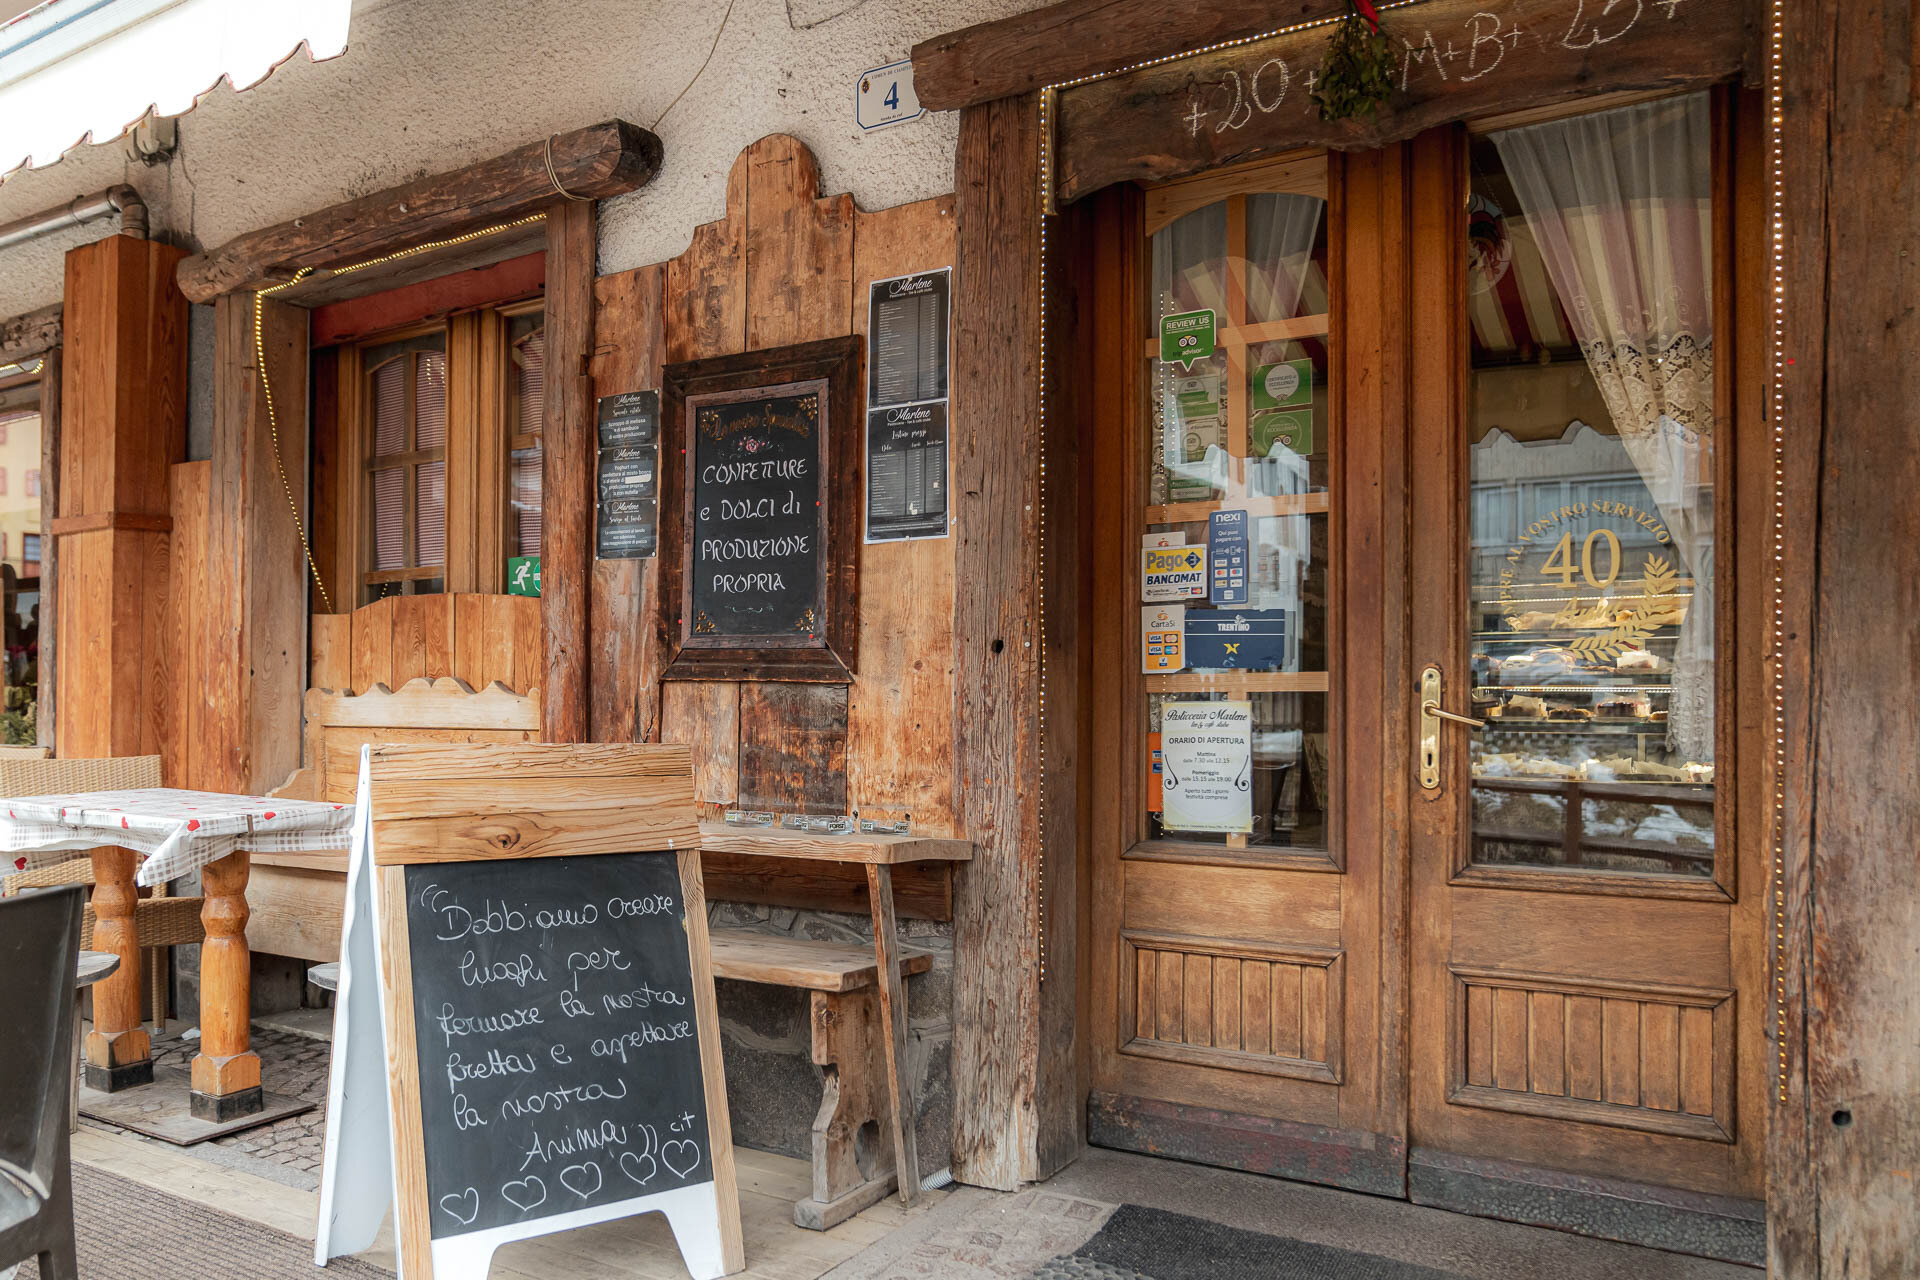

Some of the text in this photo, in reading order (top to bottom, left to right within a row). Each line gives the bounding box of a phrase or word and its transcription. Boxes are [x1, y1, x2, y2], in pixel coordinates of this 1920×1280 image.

[884, 81, 899, 110] 4
[889, 277, 932, 295] Marlene
[1166, 319, 1197, 330] REVIEW
[1198, 316, 1210, 325] US
[613, 395, 641, 406] Marlene
[886, 407, 931, 423] Marlene
[613, 448, 641, 459] Marlene
[702, 458, 808, 485] CONFETTURE
[612, 502, 639, 512] Marlene
[700, 490, 801, 521] e DOLCI di
[1215, 513, 1241, 523] nexi
[1519, 502, 1586, 543] VOSTRO
[1591, 500, 1672, 544] SERVIZIO
[702, 535, 810, 562] PRODUZIONE
[1146, 552, 1184, 571] Pago
[1540, 528, 1621, 589] 40
[713, 573, 786, 593] PROPRIA
[1146, 572, 1202, 586] BANCOMAT
[1217, 623, 1250, 632] TRENTINO
[1164, 709, 1248, 721] Pasticceria Marlene
[1168, 736, 1245, 745] ORARIO DI APERTURA
[567, 948, 631, 992] per
[560, 990, 595, 1018] la
[603, 982, 686, 1015] nostra
[550, 1043, 572, 1064] e
[453, 1078, 627, 1131] la nostra
[669, 1111, 696, 1134] cit
